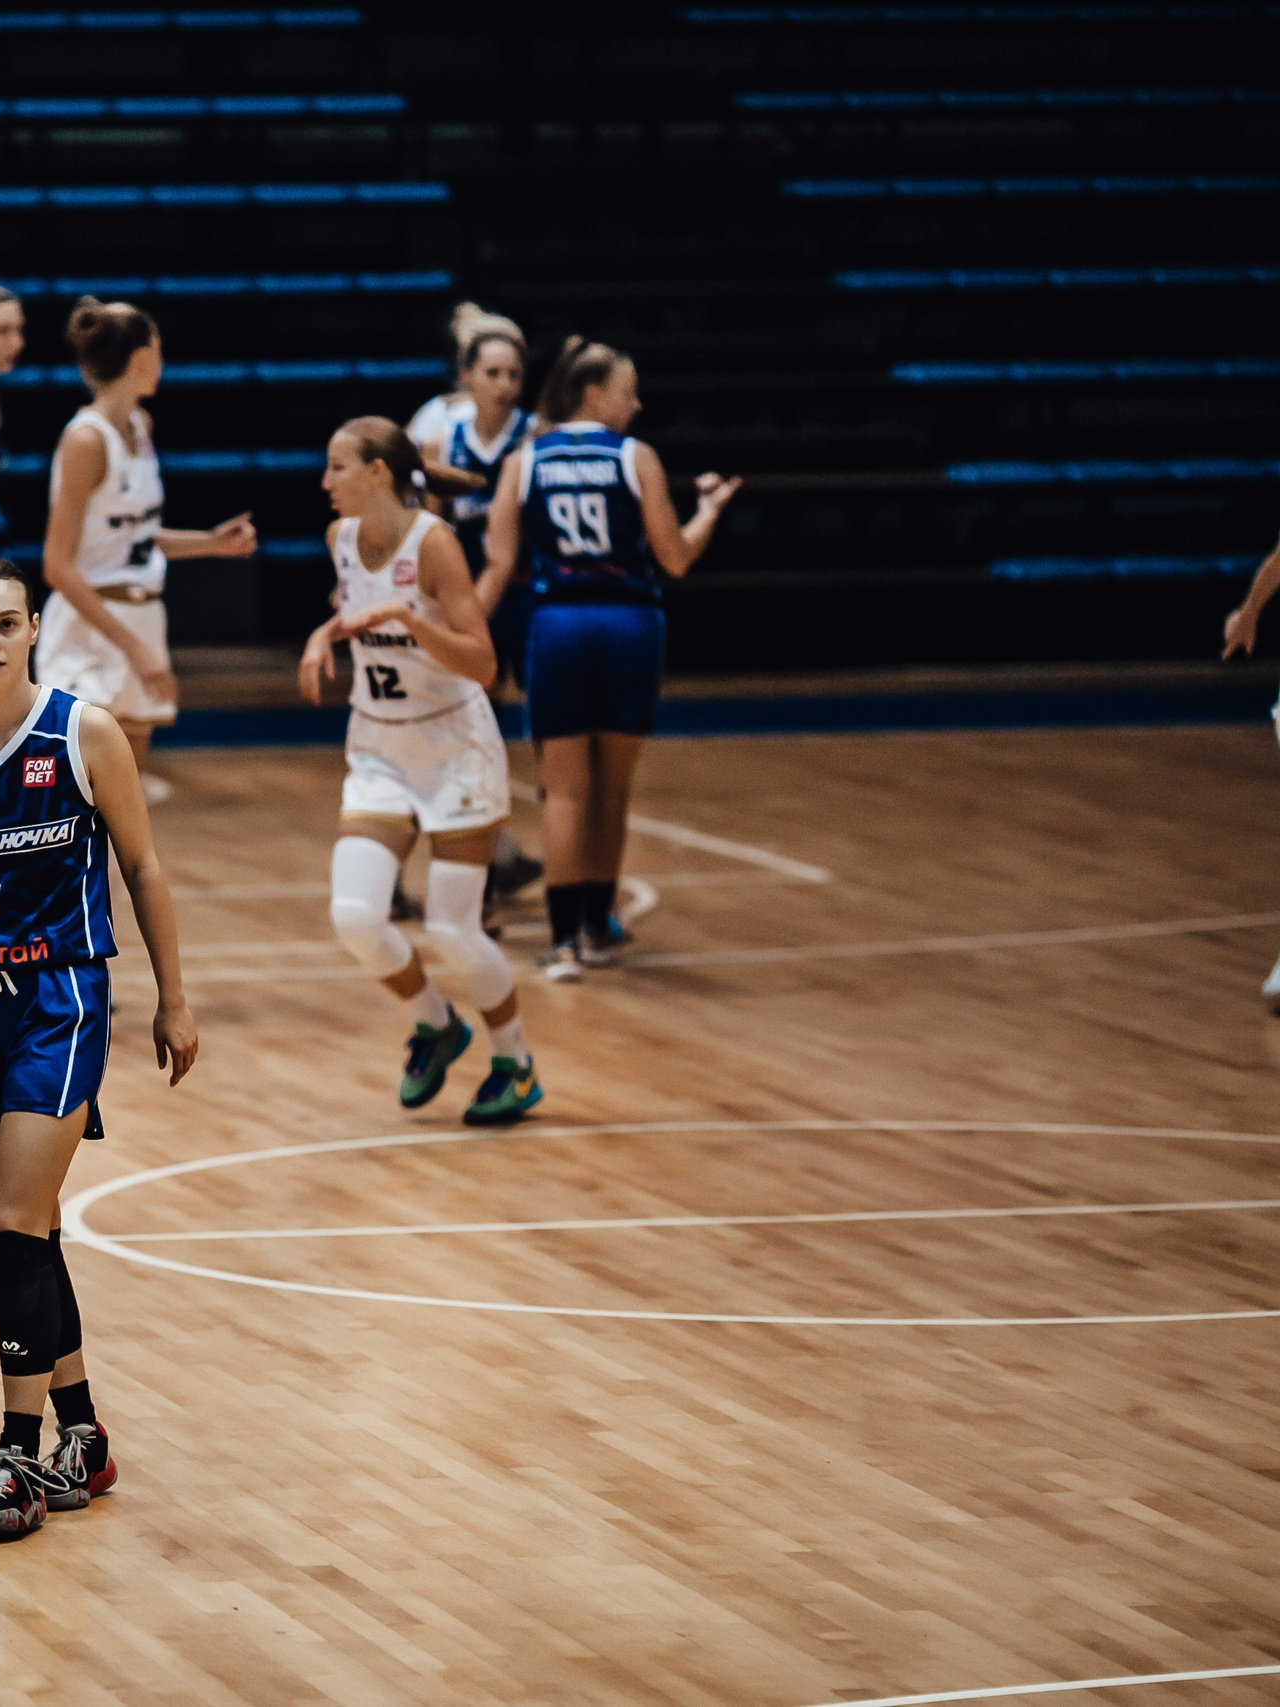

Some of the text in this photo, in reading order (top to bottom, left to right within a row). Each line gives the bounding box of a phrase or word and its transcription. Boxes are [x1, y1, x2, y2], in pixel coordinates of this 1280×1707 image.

[548, 493, 611, 556] 99
[365, 665, 407, 699] 12
[25, 759, 53, 772] FON
[25, 771, 53, 784] BET
